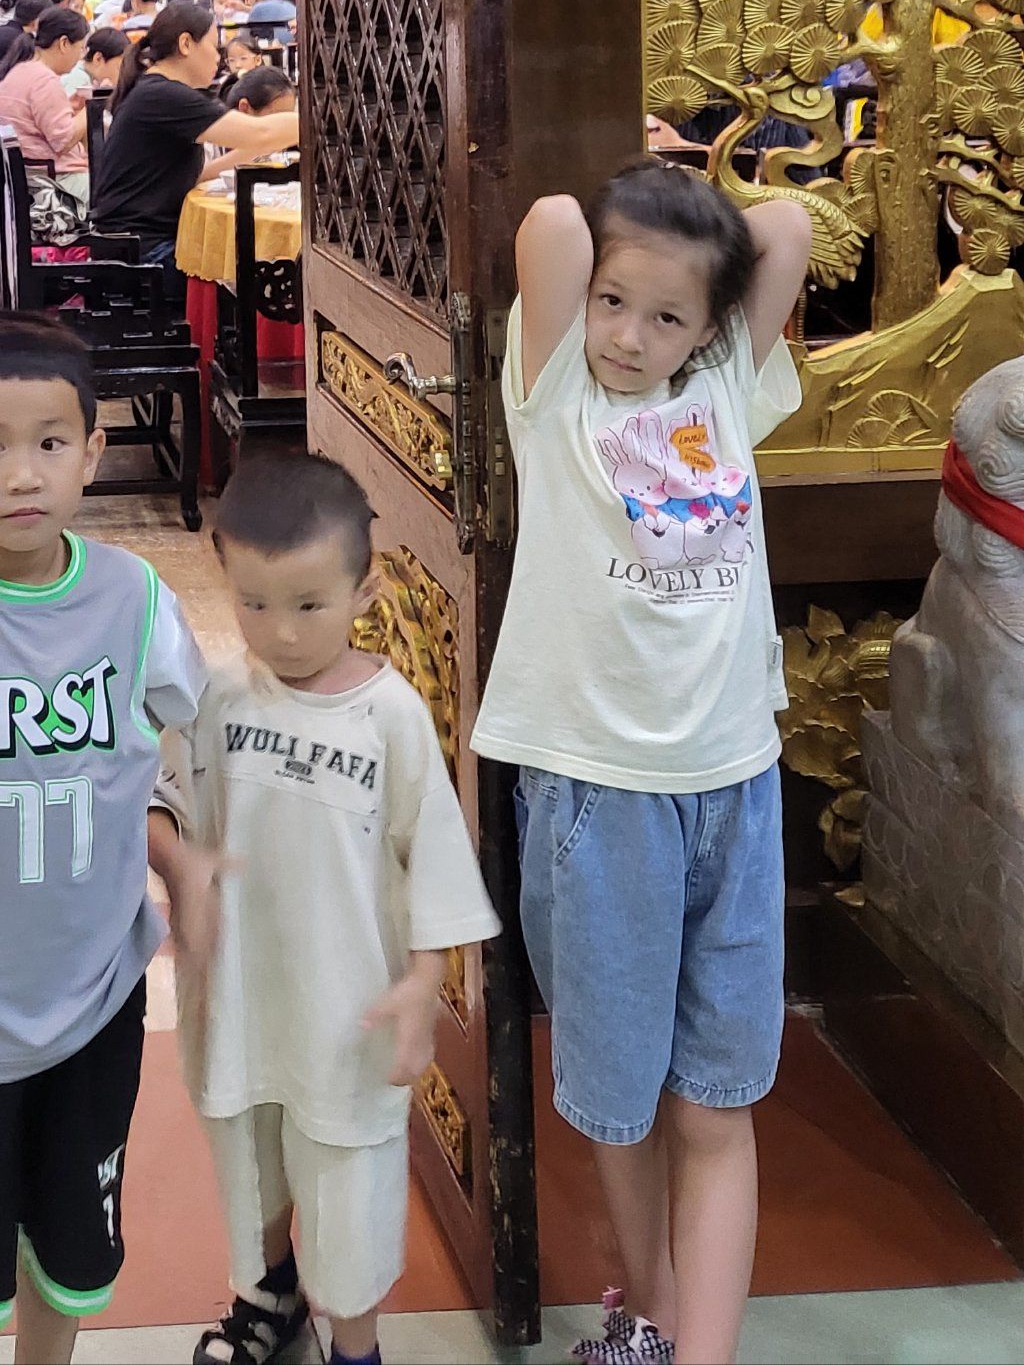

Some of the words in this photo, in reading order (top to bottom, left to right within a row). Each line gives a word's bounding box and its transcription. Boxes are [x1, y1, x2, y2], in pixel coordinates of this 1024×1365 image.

[606, 557, 705, 592] LOVELY
[225, 721, 300, 757] WULI
[308, 741, 378, 790] FAFA
